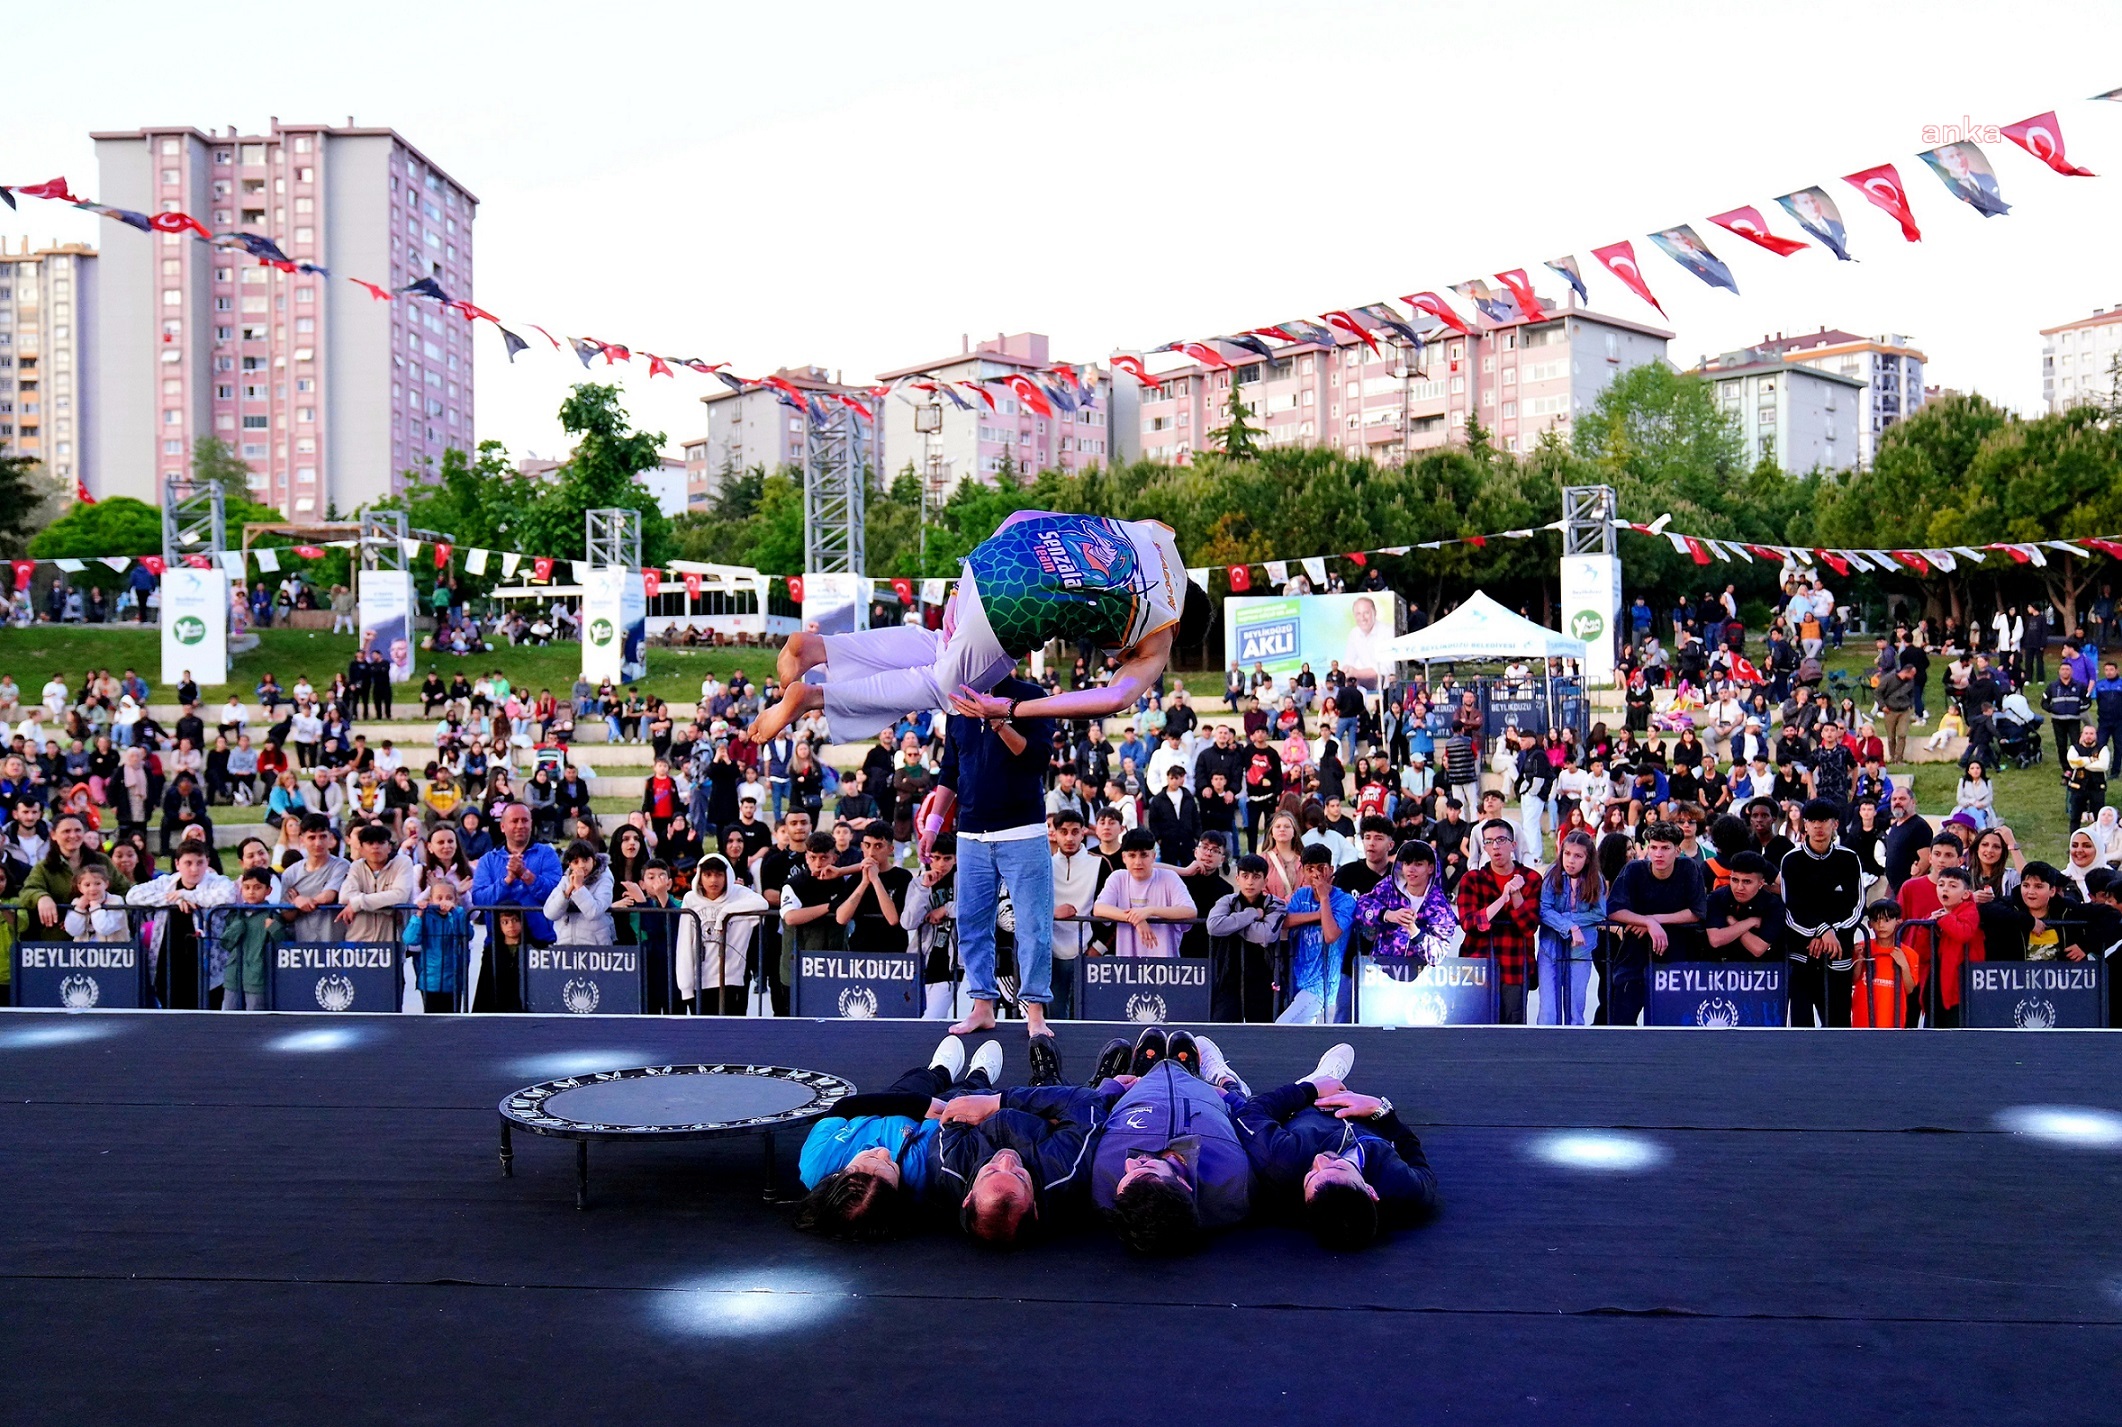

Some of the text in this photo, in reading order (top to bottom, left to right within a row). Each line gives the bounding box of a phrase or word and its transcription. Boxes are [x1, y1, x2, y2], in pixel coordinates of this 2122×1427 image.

[1033, 545, 1056, 573] team
[1242, 632, 1294, 659] AKLI
[22, 947, 135, 968] BEYLİKDÜZÜ
[278, 948, 392, 969] BEYLİKDÜZÜ
[528, 949, 636, 972] BEYLİKDÜZÜ
[801, 957, 915, 981] BEYLİKDÜZÜ
[1087, 963, 1206, 986] BEYLİKDÜZÜ
[1655, 970, 1779, 992] BEYLİKDÜZÜ
[1972, 969, 2096, 991] BEYLİKDÜZÜ
